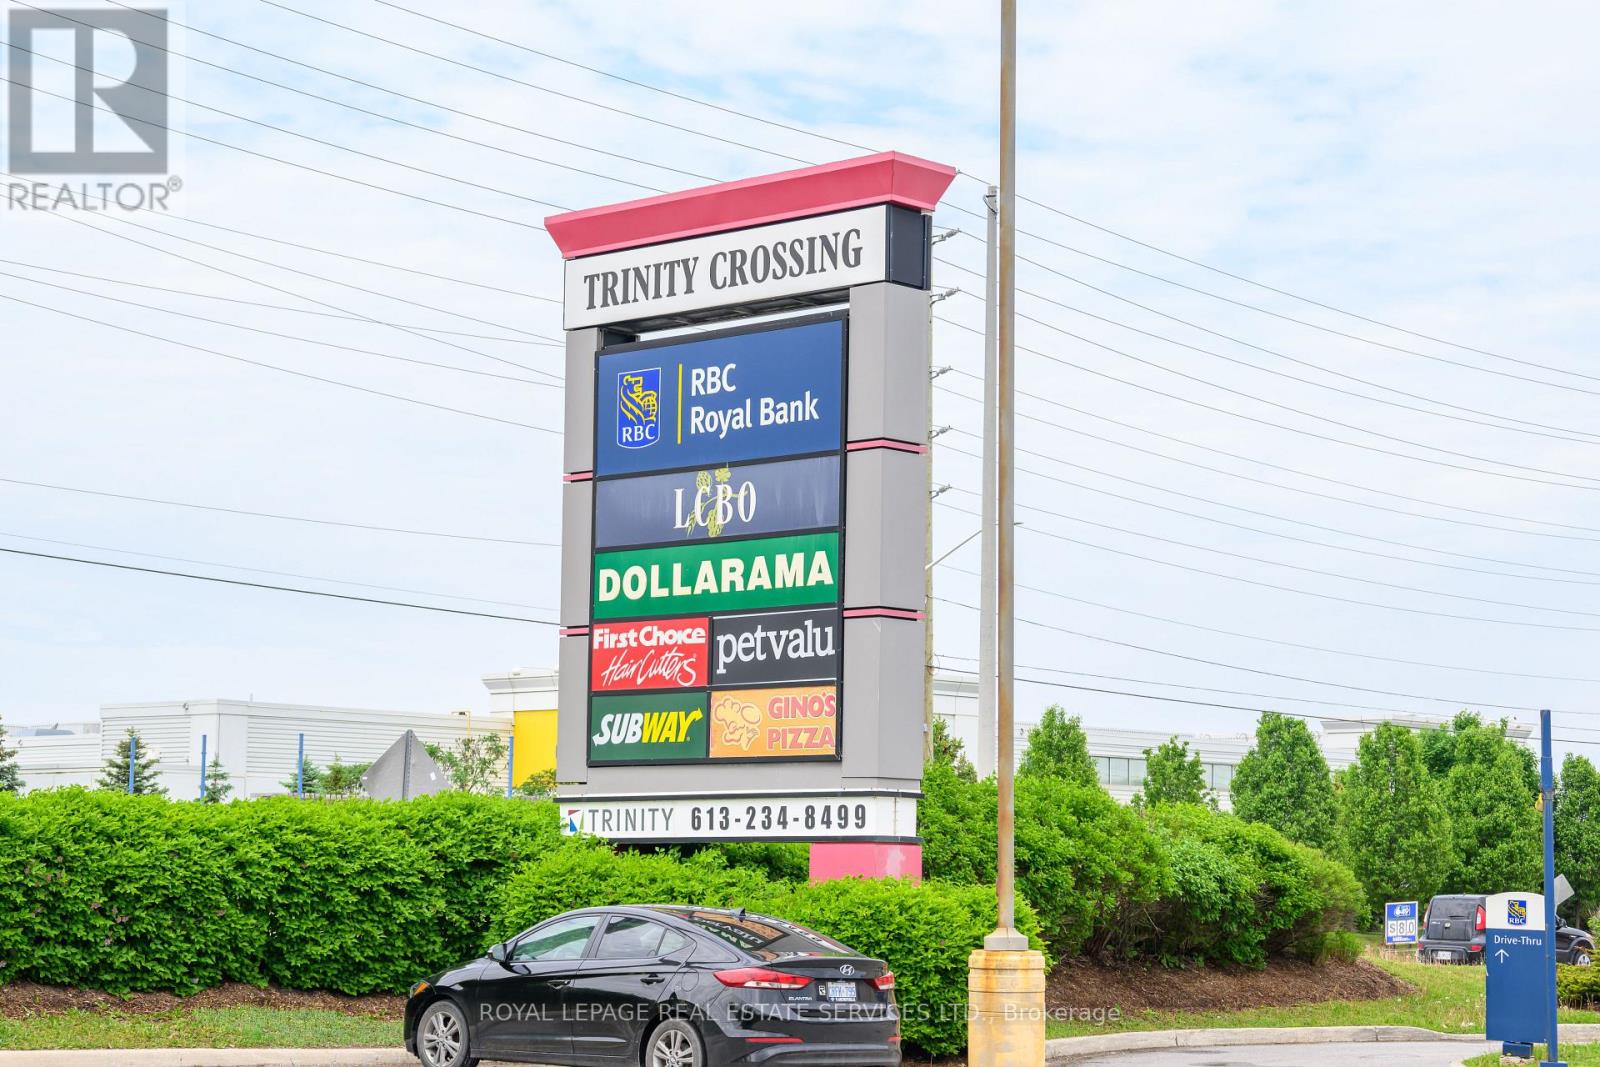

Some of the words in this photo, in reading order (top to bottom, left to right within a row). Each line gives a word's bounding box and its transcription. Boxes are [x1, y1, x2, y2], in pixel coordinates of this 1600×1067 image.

[583, 256, 699, 311] TRINITY
[709, 228, 864, 290] CROSSING
[691, 363, 737, 398] RBC
[690, 398, 753, 440] Royal
[759, 390, 820, 427] Bank
[621, 423, 657, 444] RBC
[673, 480, 757, 530] LCBO
[598, 550, 835, 602] DOLLARAMA
[592, 625, 639, 650] First
[639, 625, 706, 647] Choice
[716, 619, 836, 675] petvalu
[767, 691, 837, 720] GINO'S
[592, 706, 704, 747] SUBWAY
[767, 726, 837, 751] PIZZA
[588, 808, 674, 832] TRINITY
[691, 804, 867, 831] 613-234-8499
[1509, 917, 1526, 925] RBC
[1494, 934, 1542, 946] Drive-Thru
